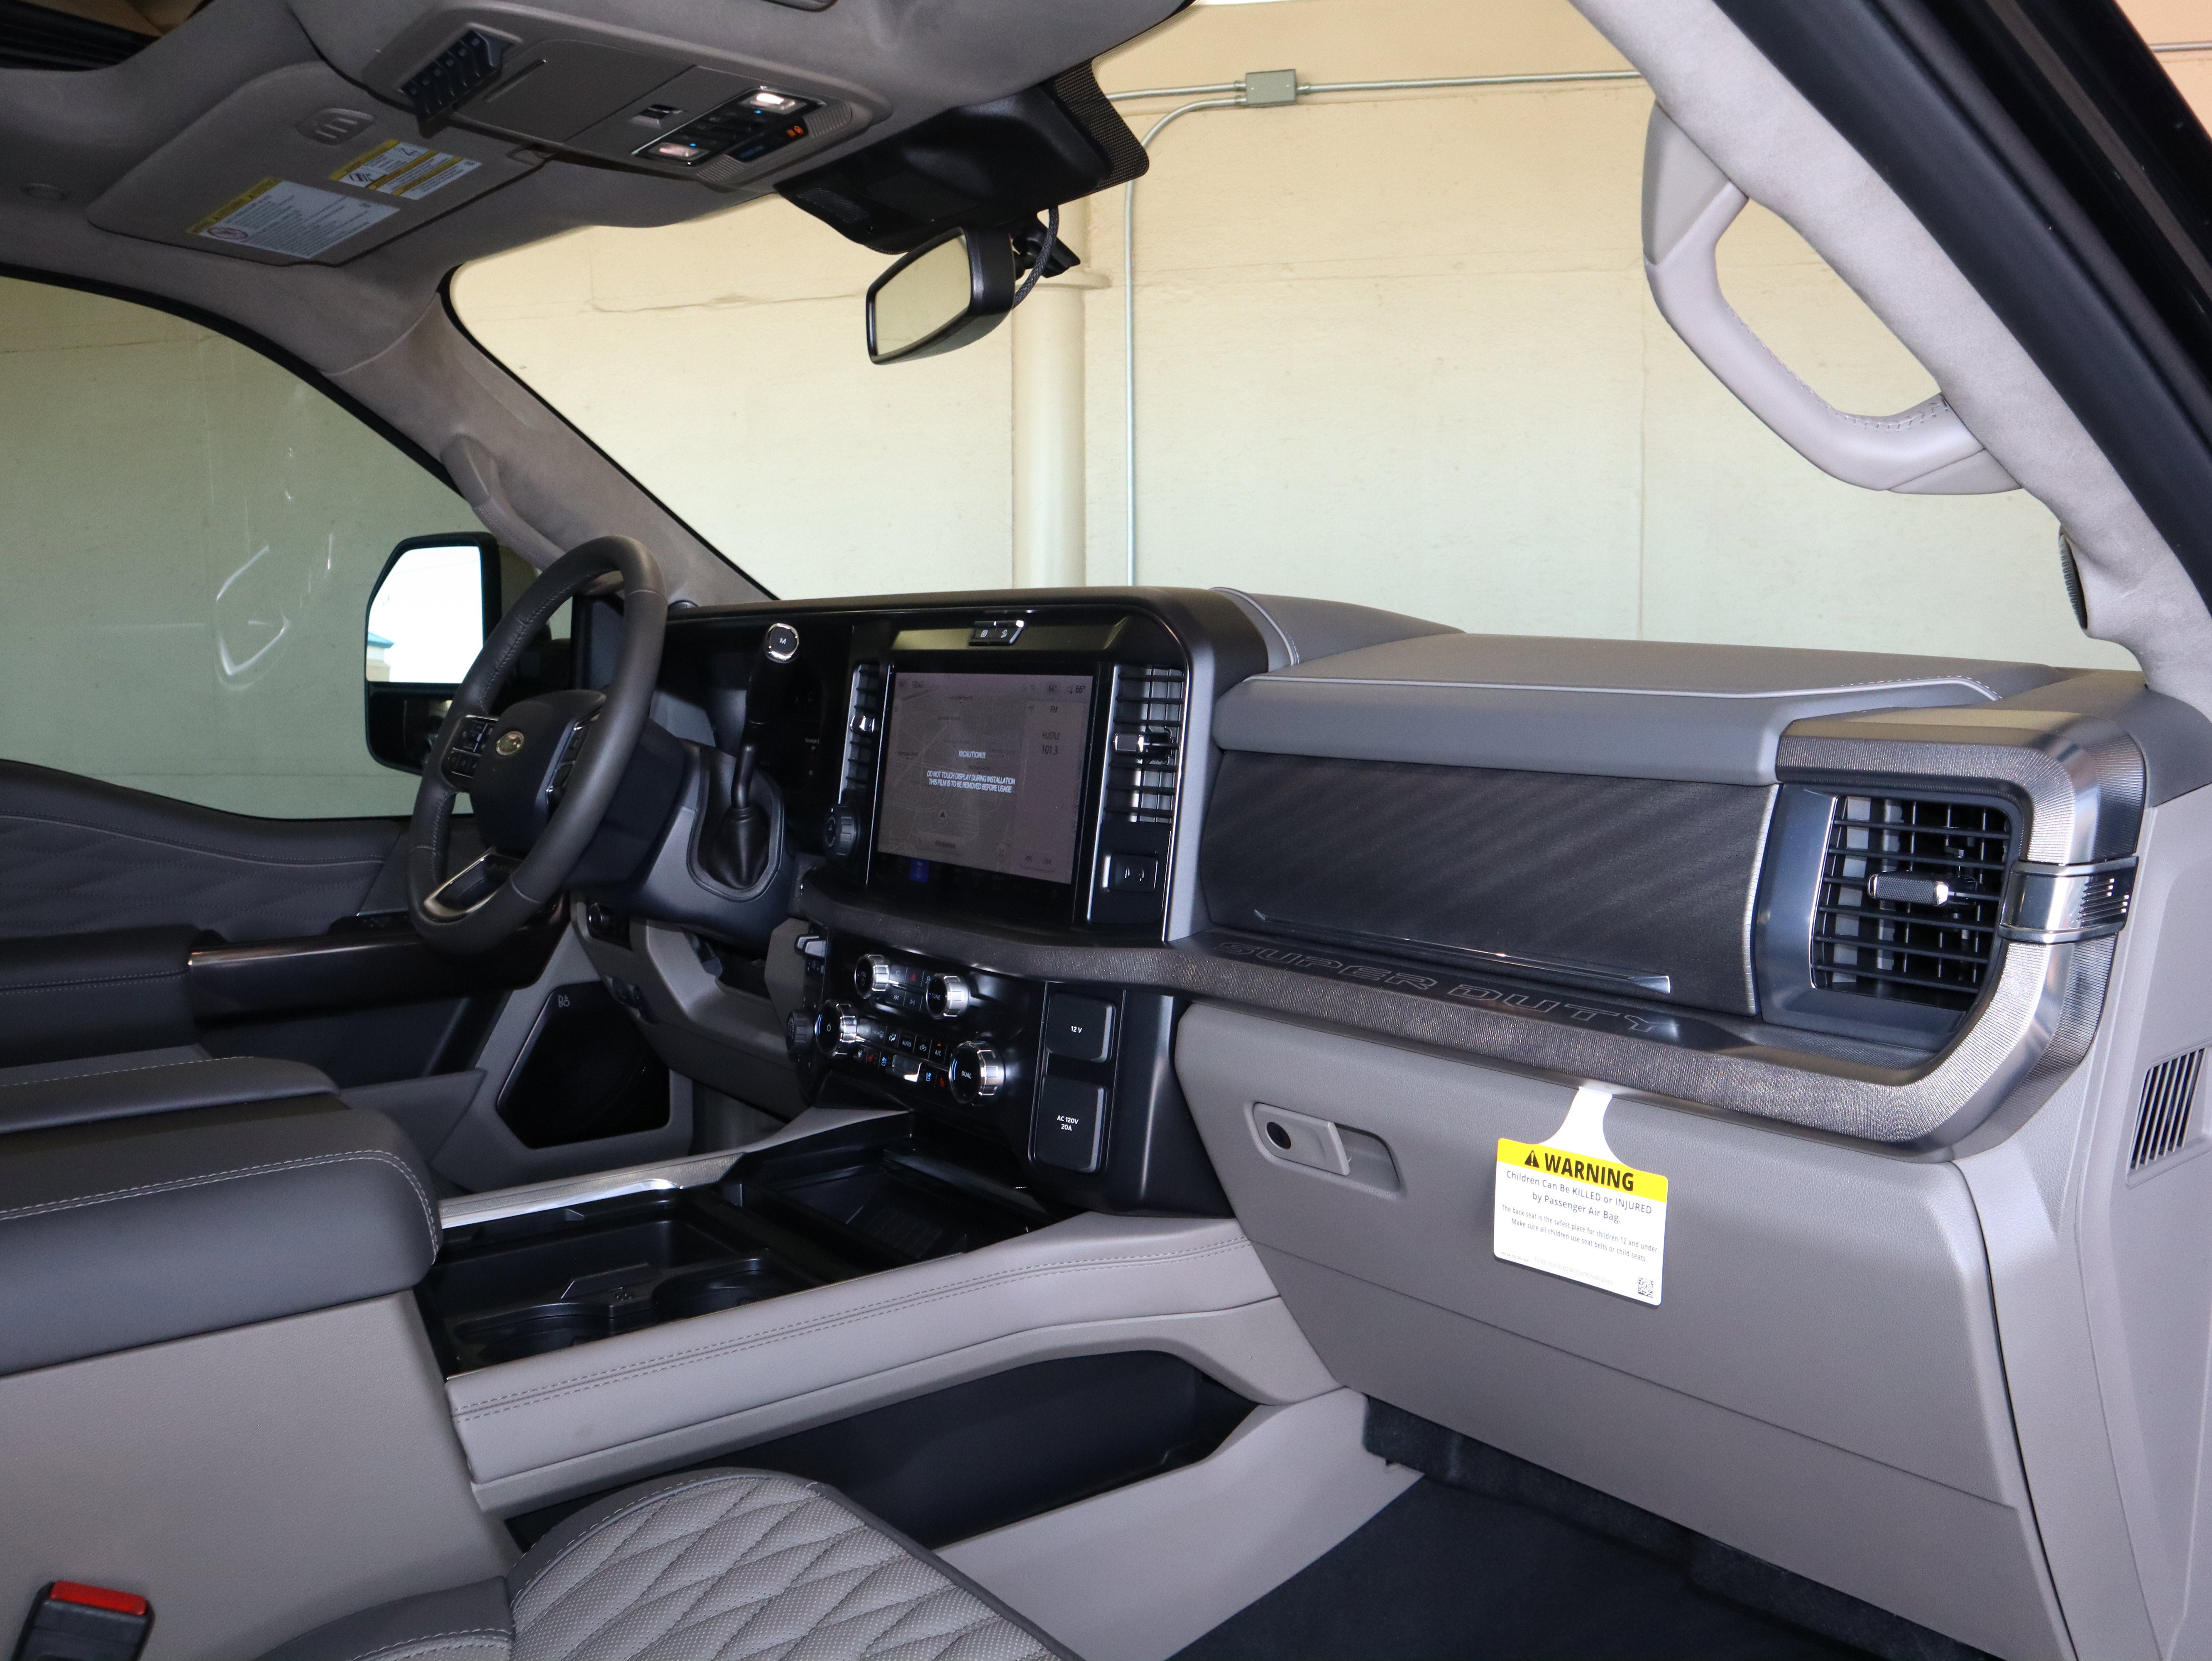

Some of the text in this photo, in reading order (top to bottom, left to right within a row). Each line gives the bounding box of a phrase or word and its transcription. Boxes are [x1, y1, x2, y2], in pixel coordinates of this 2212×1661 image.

[1075, 685, 1086, 694] 66°
[1042, 745, 1058, 755] 101.3
[962, 782, 981, 790] REMOVED
[981, 783, 998, 791] BEFORE
[998, 785, 1012, 793] USAGE
[987, 776, 1015, 784] INSTALLATION
[1213, 942, 1678, 1033] SUPER DUTY
[961, 1070, 972, 1079] DUAL
[1544, 1153, 1634, 1192] WARNING
[1507, 1170, 1539, 1186] Children
[1542, 1180, 1557, 1190] Can
[1560, 1184, 1570, 1193] Be
[1573, 1187, 1601, 1201] KILLED
[1615, 1198, 1652, 1214] INJURED
[1533, 1191, 1621, 1224] by Passenger Air Bag.
[1502, 1204, 1511, 1213] The
[1512, 1207, 1524, 1216] back
[1544, 1216, 1553, 1224] the
[1554, 1219, 1570, 1229] safest
[1571, 1223, 1585, 1233] place
[1596, 1230, 1618, 1242] children
[1628, 1240, 1639, 1248] and
[1641, 1243, 1659, 1254] under.
[1512, 1218, 1525, 1228] Make
[1548, 1228, 1569, 1240] children
[1594, 1242, 1607, 1251] belts
[1617, 1247, 1630, 1257] child
[1631, 1252, 1648, 1263] seats.
[1547, 1262, 1568, 1272] REMOVED
[1576, 1269, 1600, 1281] CUSTOMER
[1601, 1277, 1613, 1286] ONLY
